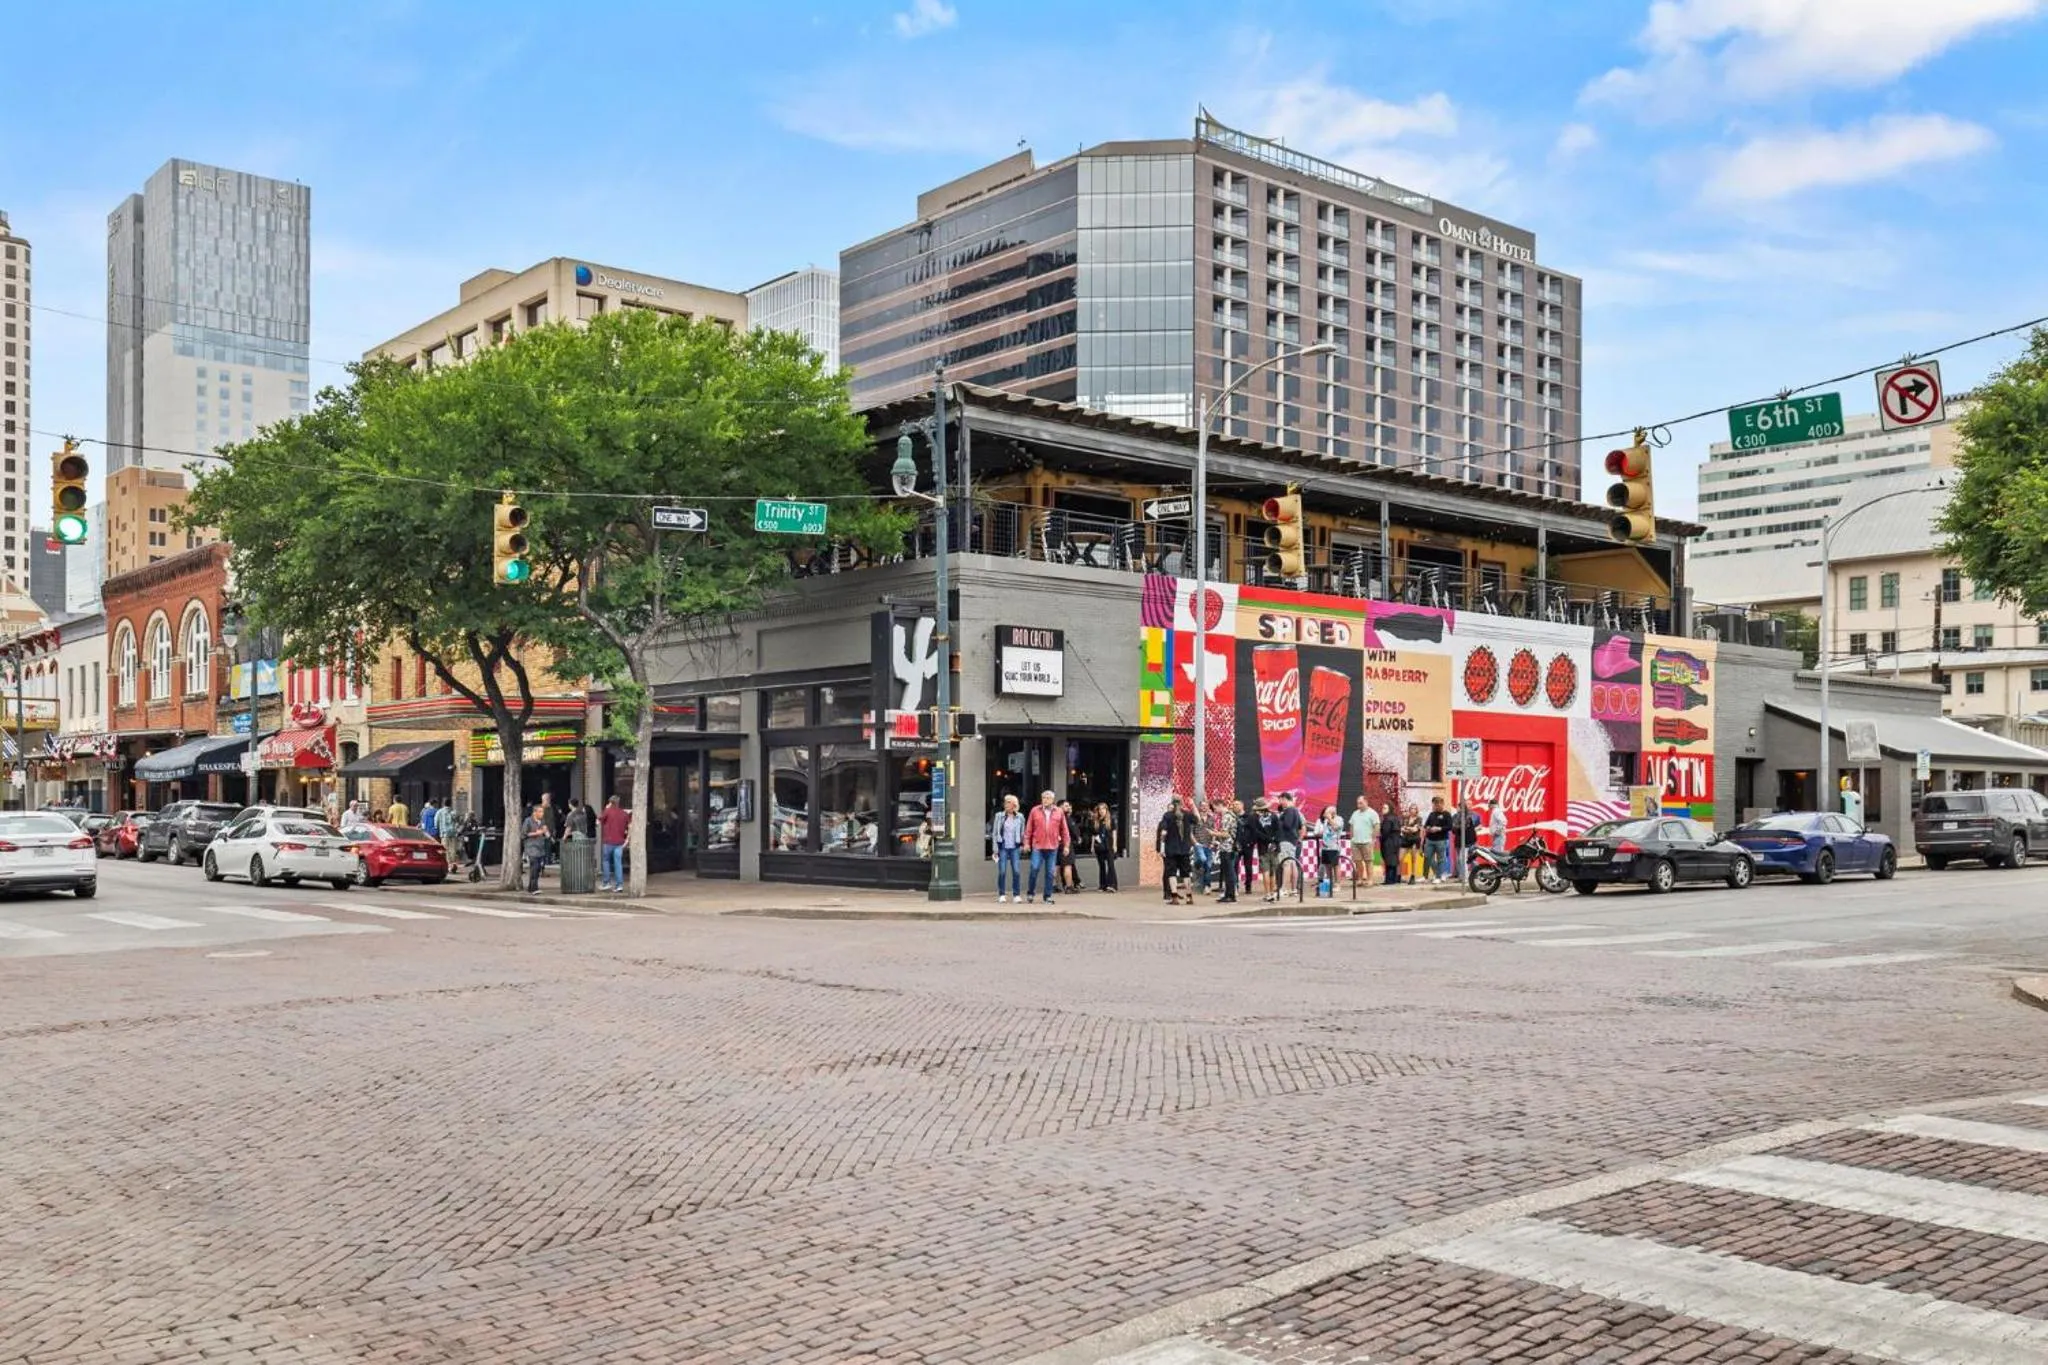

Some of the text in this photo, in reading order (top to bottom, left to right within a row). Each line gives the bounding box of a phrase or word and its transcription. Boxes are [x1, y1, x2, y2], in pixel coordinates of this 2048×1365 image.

[1439, 217, 1534, 263] OMNI HOTEL
[1745, 397, 1824, 431] E 6th ST
[1743, 424, 1833, 448] 300 400
[764, 503, 820, 522] Trinity ST
[1258, 613, 1351, 646] SPICED
[1367, 649, 1397, 662] WITH
[1365, 666, 1429, 683] RASPBERRY
[1365, 699, 1406, 714] SPICED
[1262, 717, 1297, 731] SPICED
[1365, 718, 1414, 731] FLAVORS
[1646, 755, 1707, 798] AUSTIN
[1130, 759, 1139, 838] PASTE
